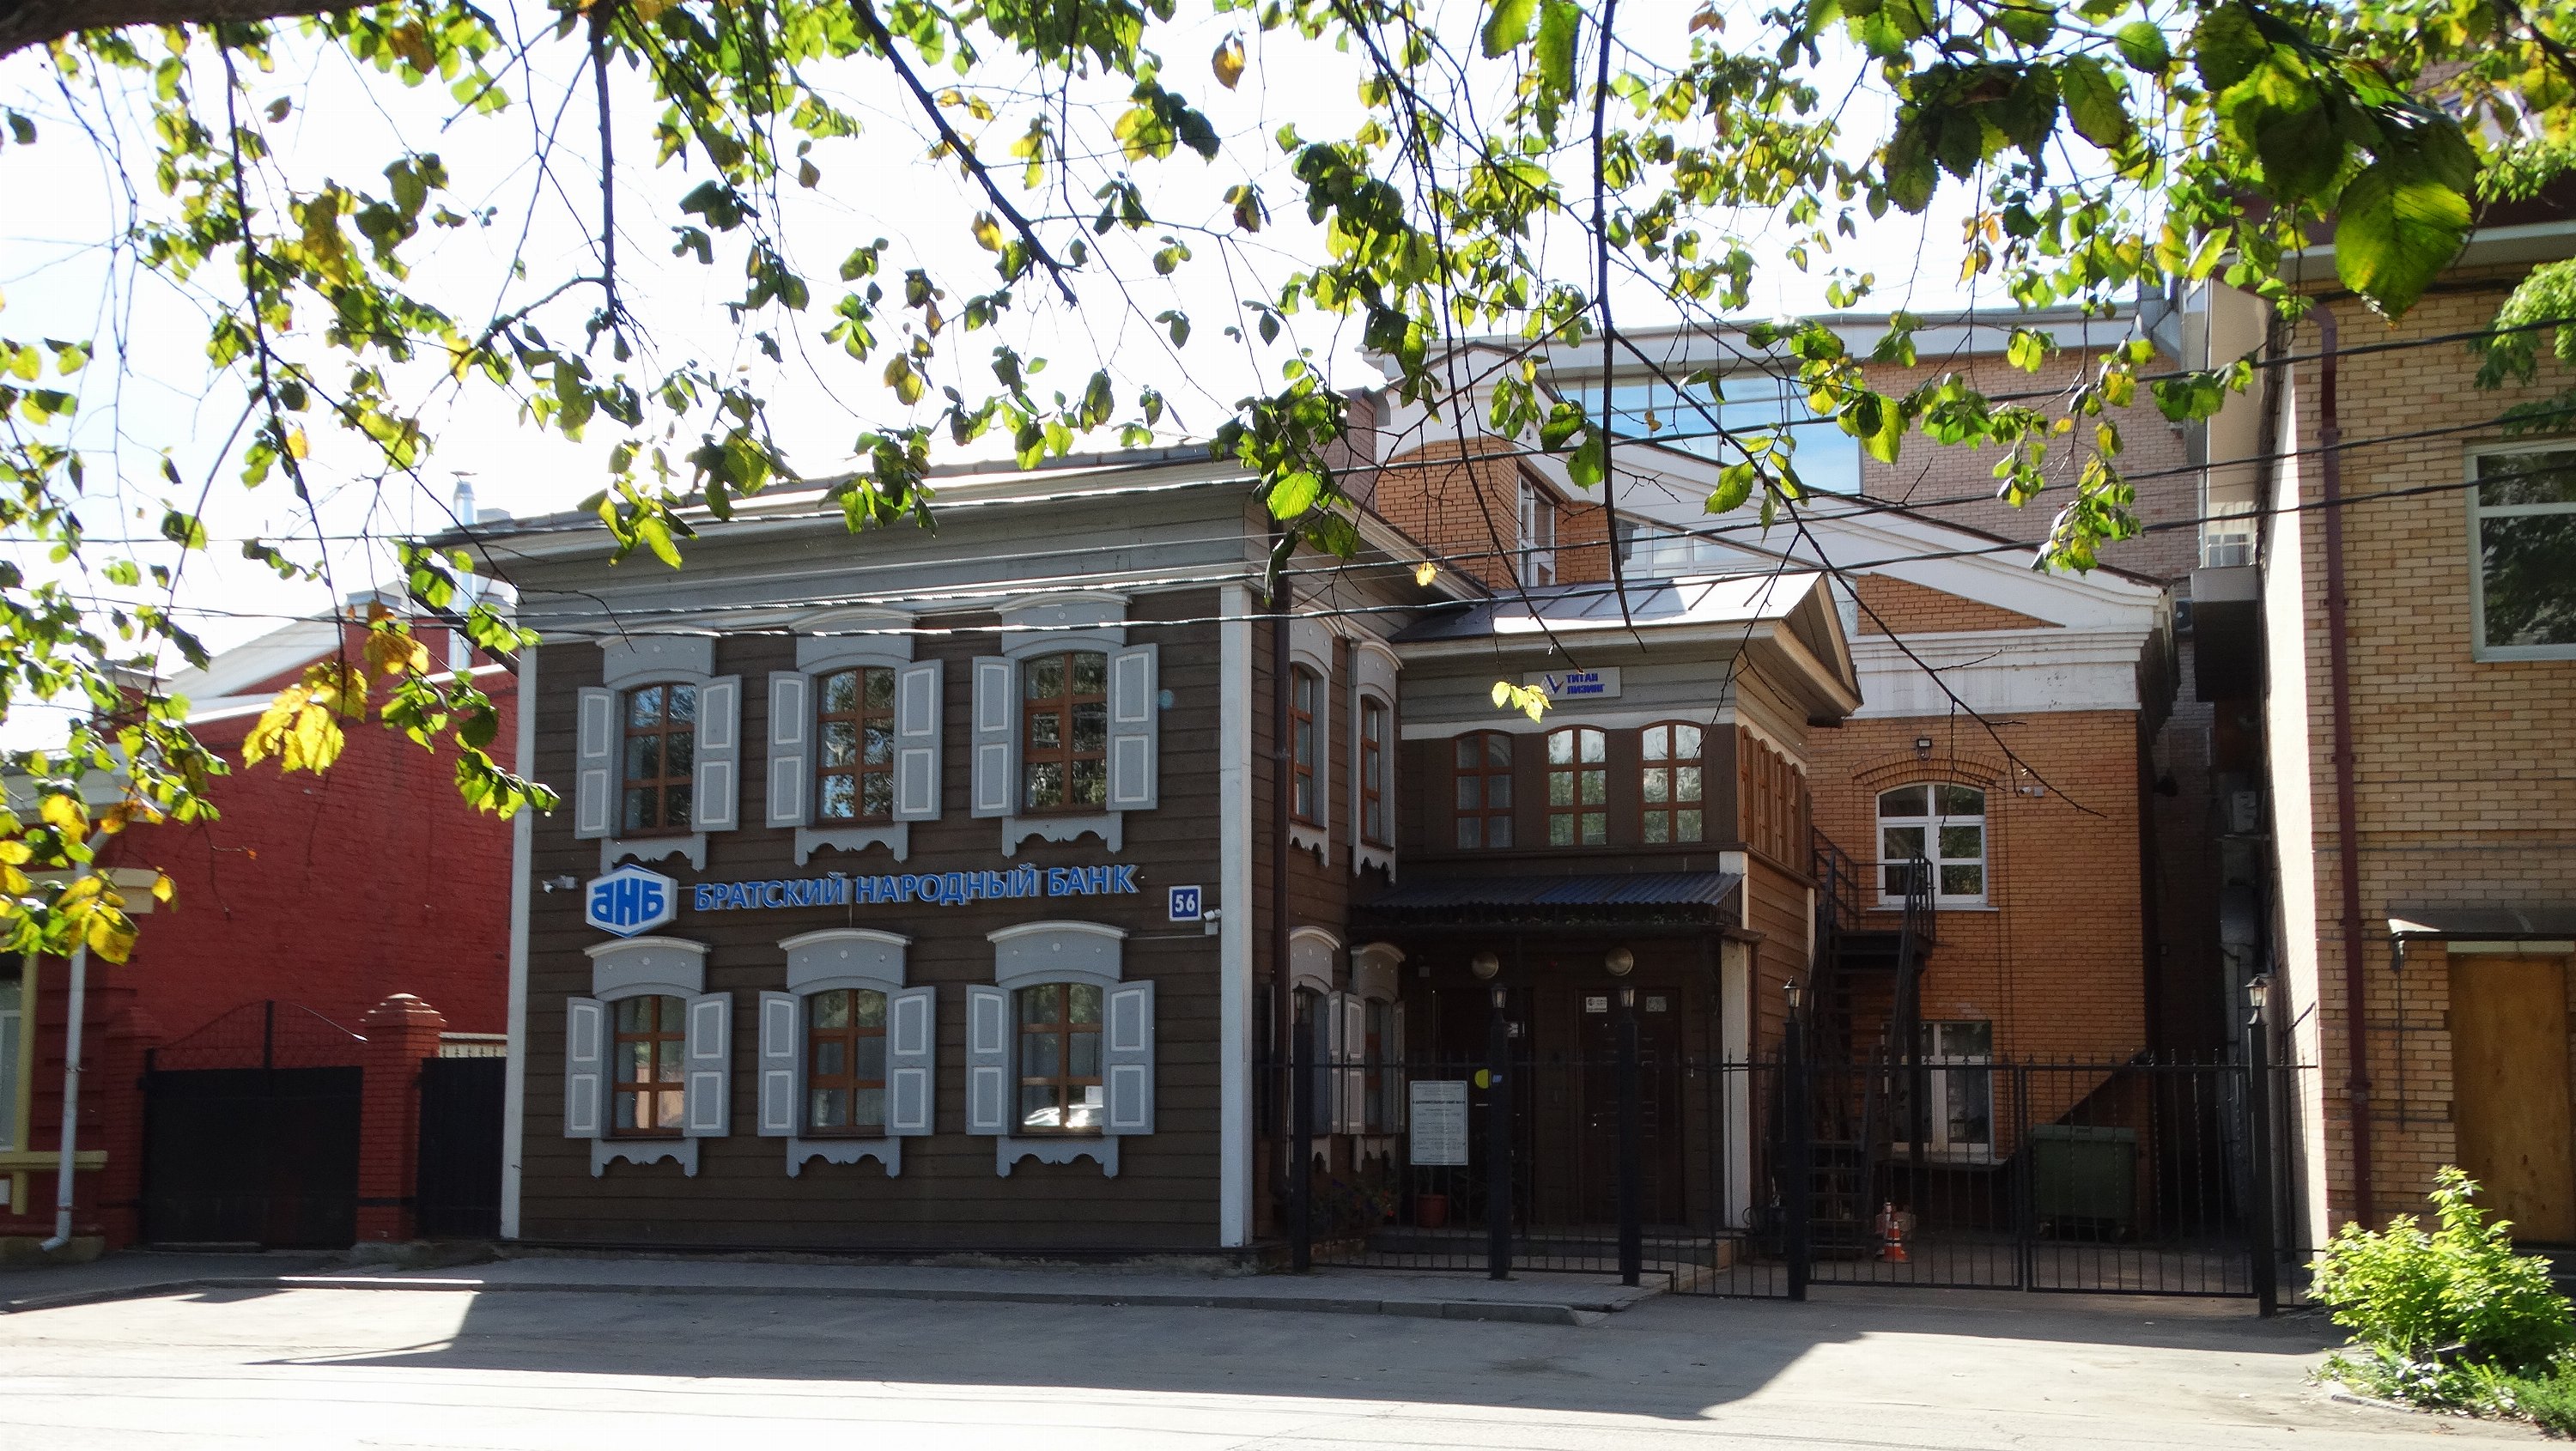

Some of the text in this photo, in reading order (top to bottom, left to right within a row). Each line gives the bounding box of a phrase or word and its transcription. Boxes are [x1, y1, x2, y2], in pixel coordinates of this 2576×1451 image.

[1566, 673, 1599, 683] ТИТАН
[1567, 684, 1605, 695] ЛИЗИНГ
[694, 862, 1138, 912] БРАТСКИЙ НАРОДНЫЙ БАНК
[1174, 894, 1196, 914] 56
